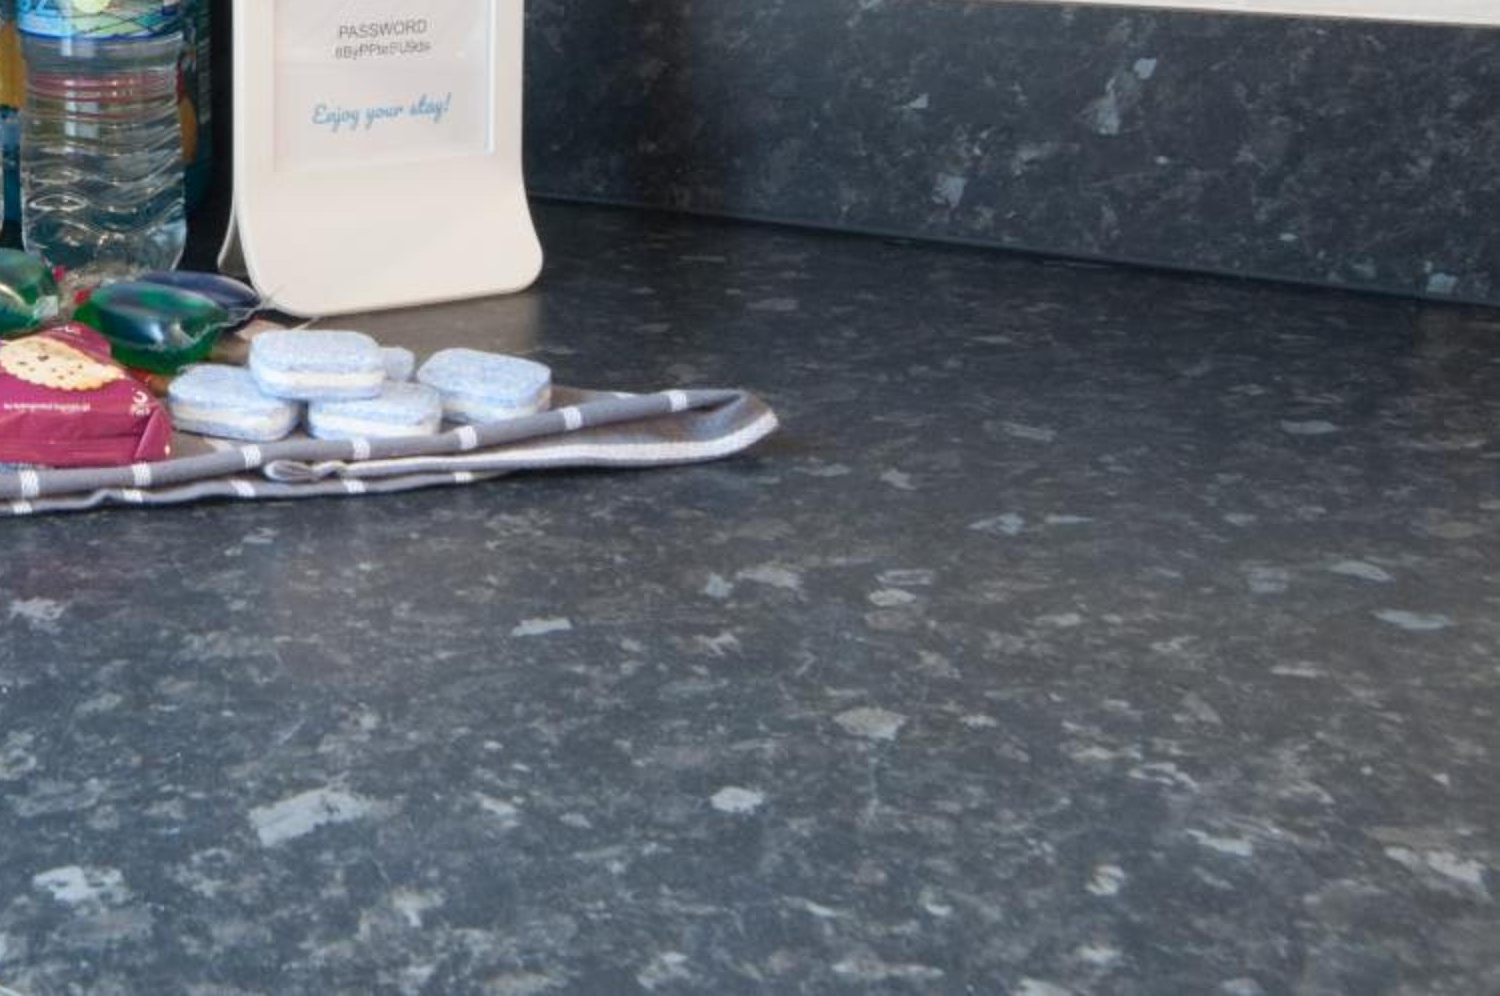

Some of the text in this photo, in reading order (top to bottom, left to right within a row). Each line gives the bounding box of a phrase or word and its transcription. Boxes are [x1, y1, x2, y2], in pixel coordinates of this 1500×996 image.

[338, 18, 428, 39] PASSWORD
[312, 91, 452, 133] Enjoy your stay!
